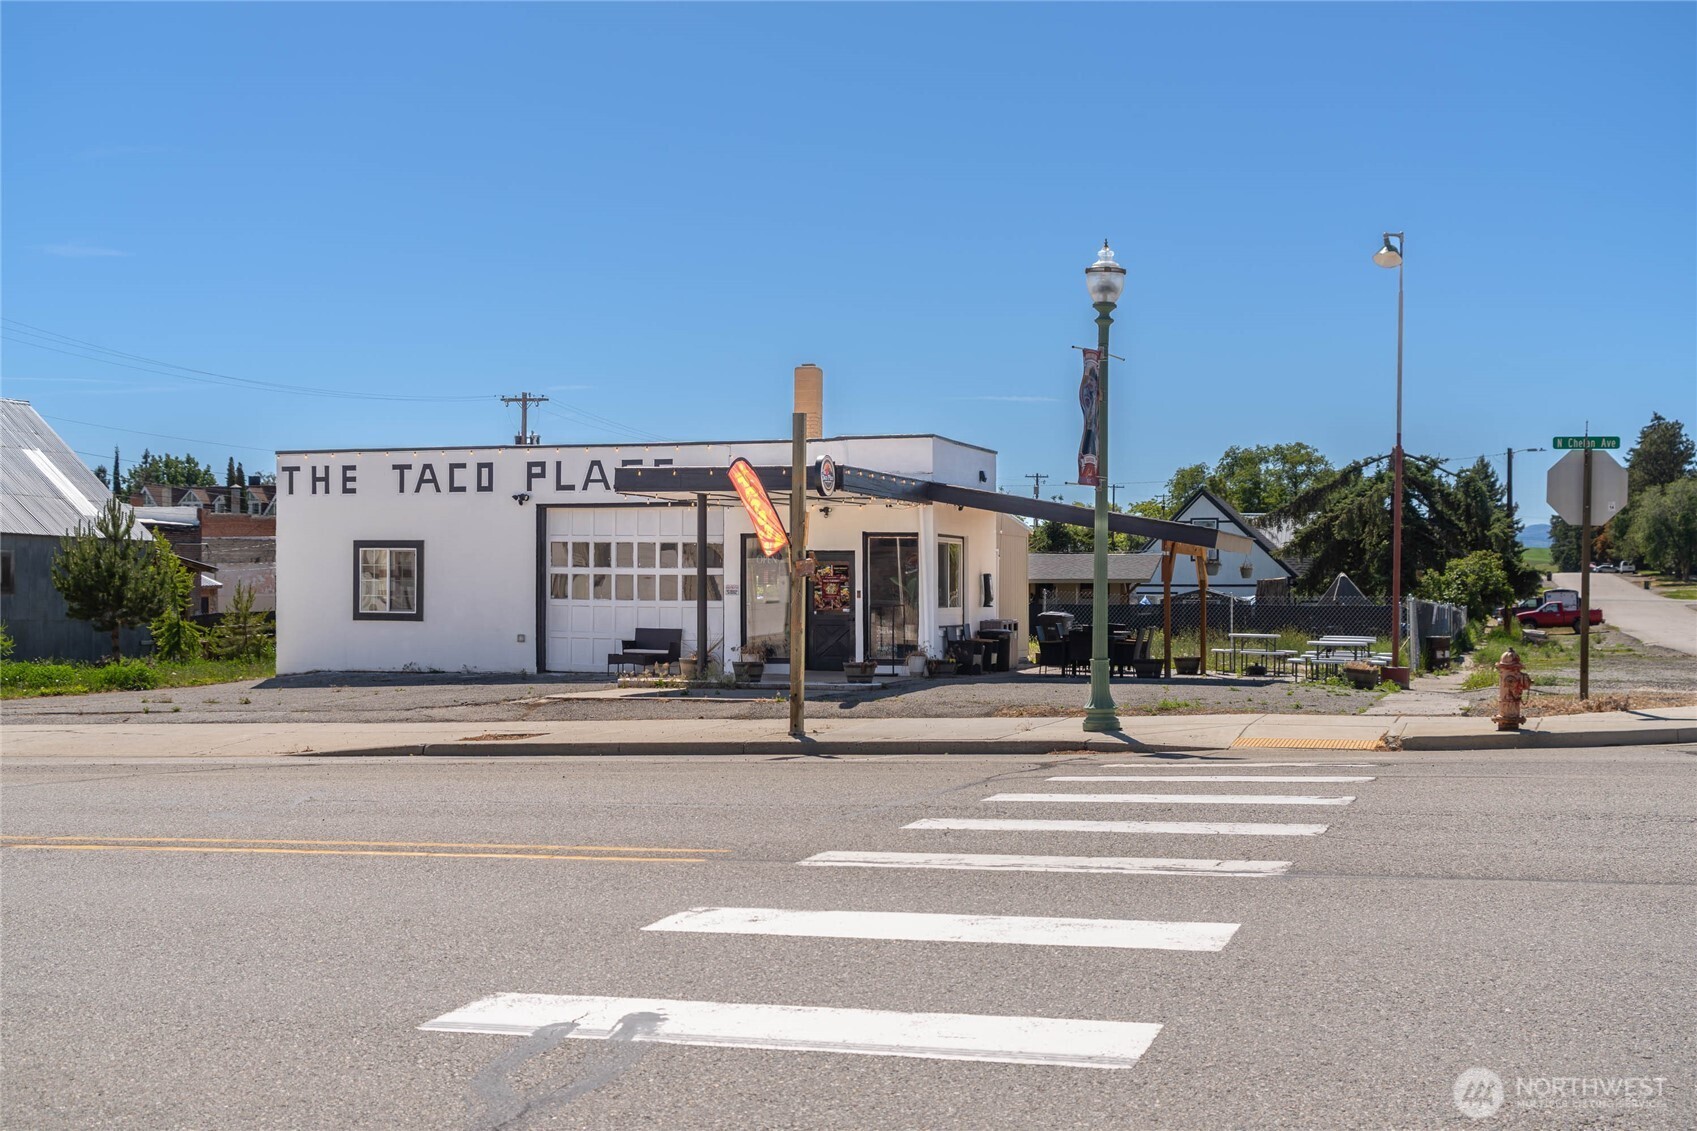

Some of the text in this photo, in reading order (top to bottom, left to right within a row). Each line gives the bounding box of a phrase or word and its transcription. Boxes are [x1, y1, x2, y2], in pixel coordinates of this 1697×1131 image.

[1557, 438, 1563, 448] N
[1600, 438, 1617, 448] Ave
[281, 458, 674, 495] THE TACO PLA
